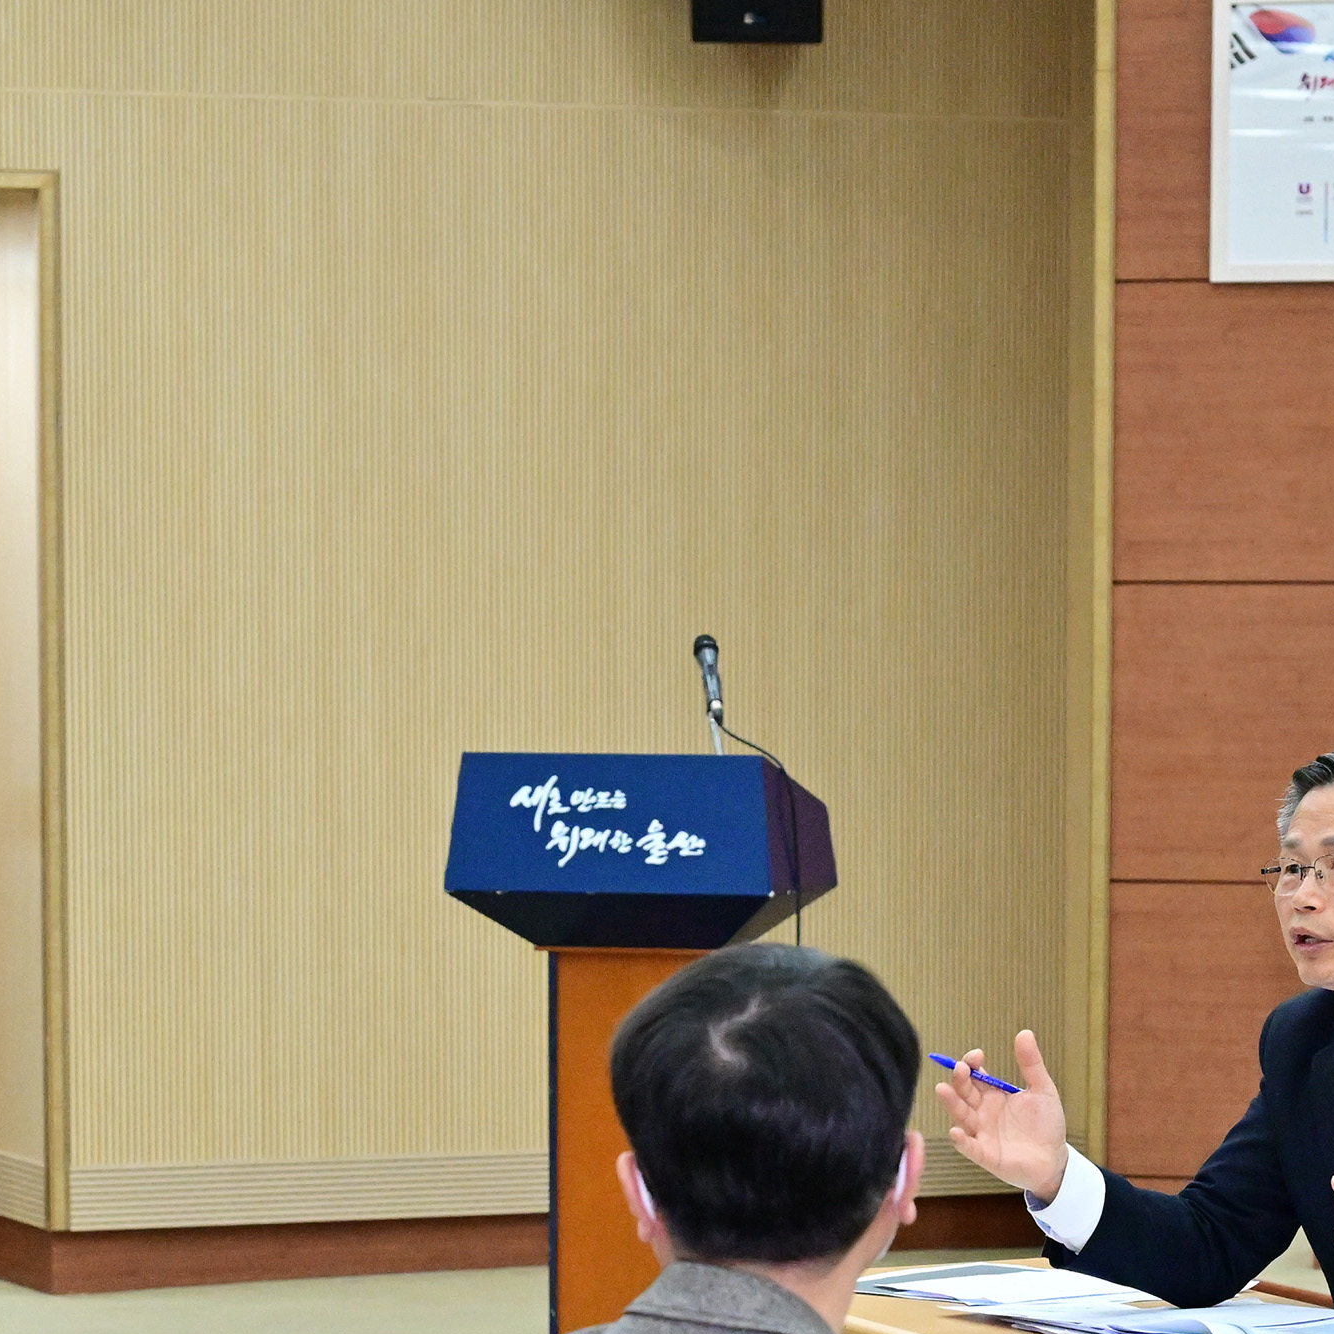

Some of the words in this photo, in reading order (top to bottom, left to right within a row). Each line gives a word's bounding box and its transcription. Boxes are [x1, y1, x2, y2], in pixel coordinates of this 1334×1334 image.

[509, 774, 571, 832] 새로
[570, 787, 627, 813] 만드는
[545, 820, 633, 868] 위대한
[636, 818, 707, 865] 울산
